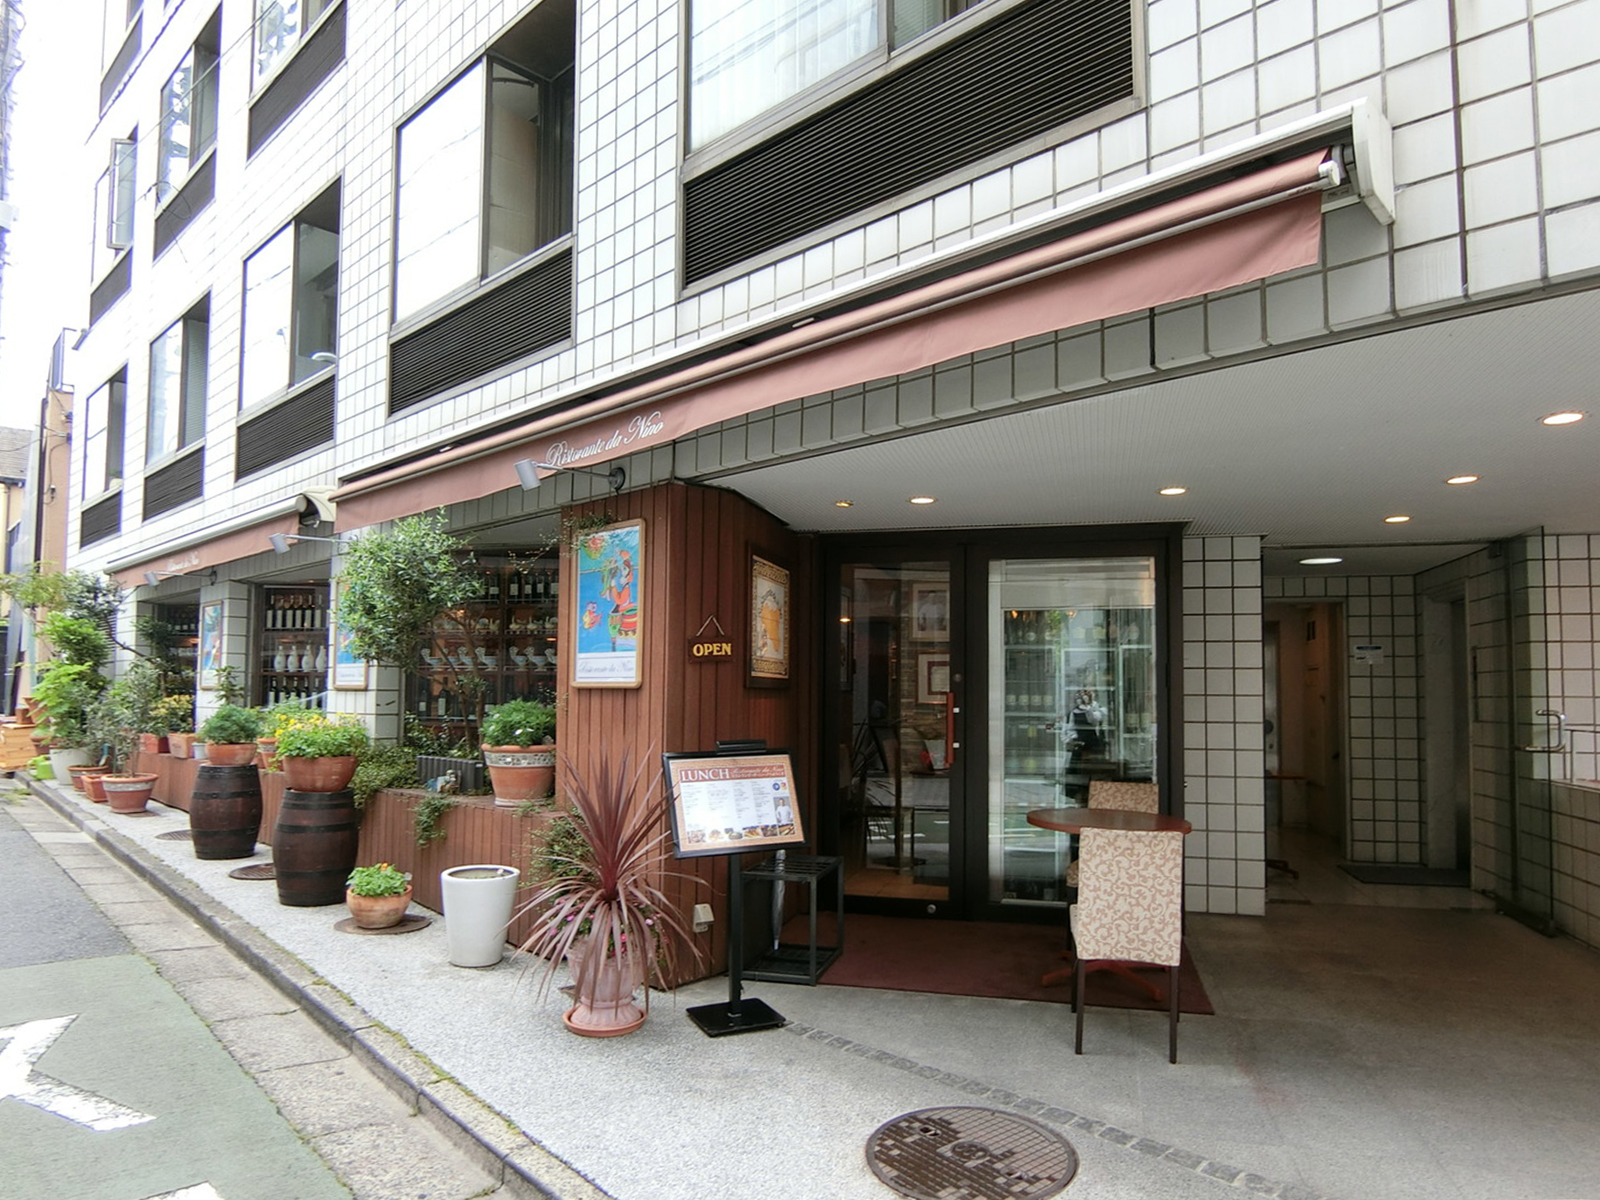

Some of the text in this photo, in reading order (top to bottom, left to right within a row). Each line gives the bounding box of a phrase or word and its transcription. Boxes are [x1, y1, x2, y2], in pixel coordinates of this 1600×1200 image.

[546, 411, 664, 467] Ristorante da Nino
[692, 643, 732, 656] OPEN
[681, 768, 730, 781] LUNCH
